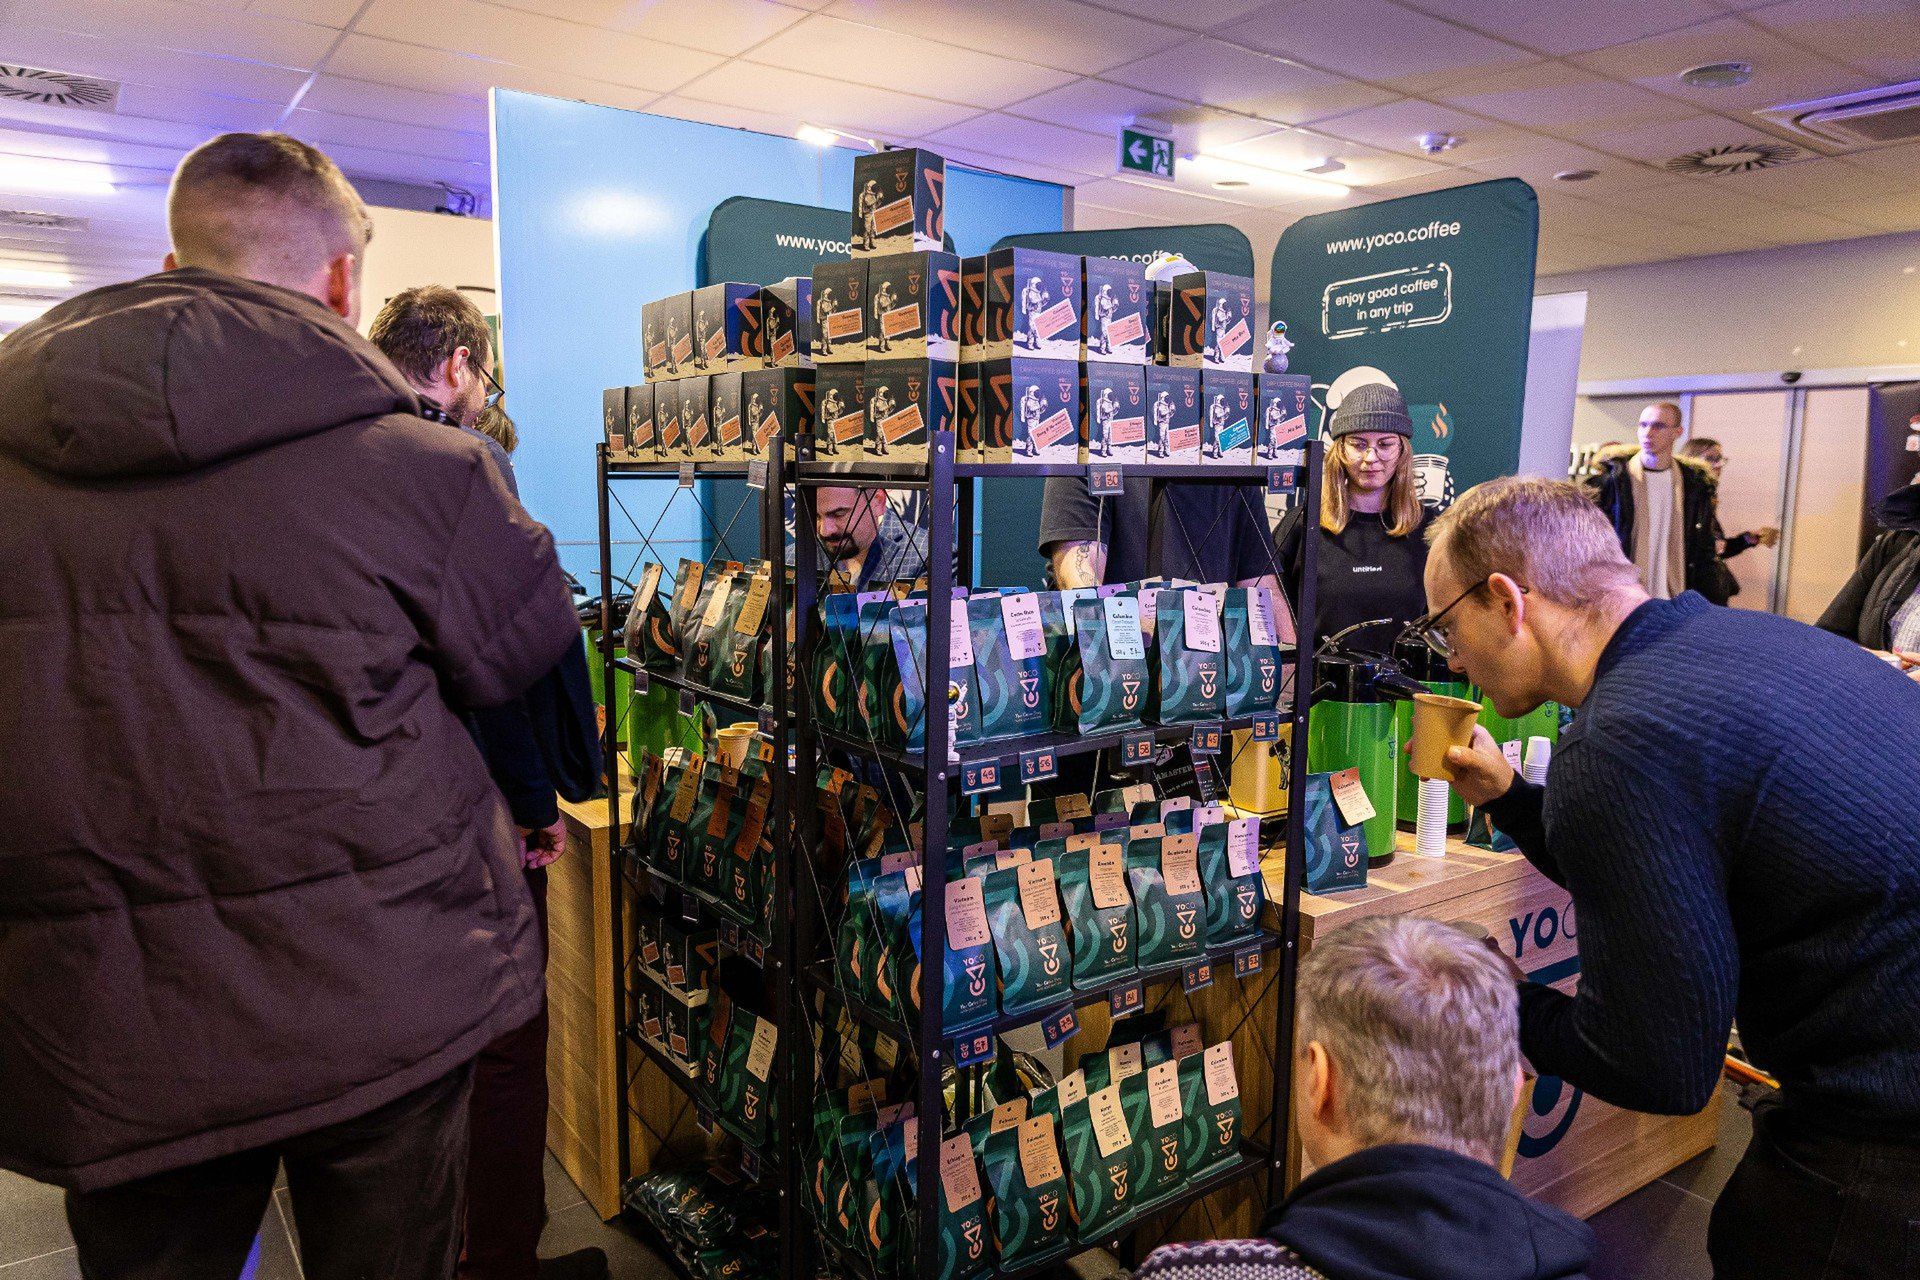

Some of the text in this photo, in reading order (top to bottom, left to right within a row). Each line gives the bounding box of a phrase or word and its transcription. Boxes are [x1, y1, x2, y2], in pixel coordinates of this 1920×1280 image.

[1326, 221, 1462, 254] www.yoco.coffee
[1335, 278, 1438, 306] enjoy good coffee
[1357, 301, 1414, 321] in any trip
[1106, 473, 1118, 485] 30
[1352, 565, 1383, 573] untitled
[1207, 734, 1218, 744] 45
[1139, 743, 1150, 755] 58
[1039, 758, 1051, 768] 56
[982, 769, 994, 780] 49
[1175, 901, 1195, 910] YOCO
[1036, 934, 1056, 946] YOCO
[962, 953, 985, 966] YOCO
